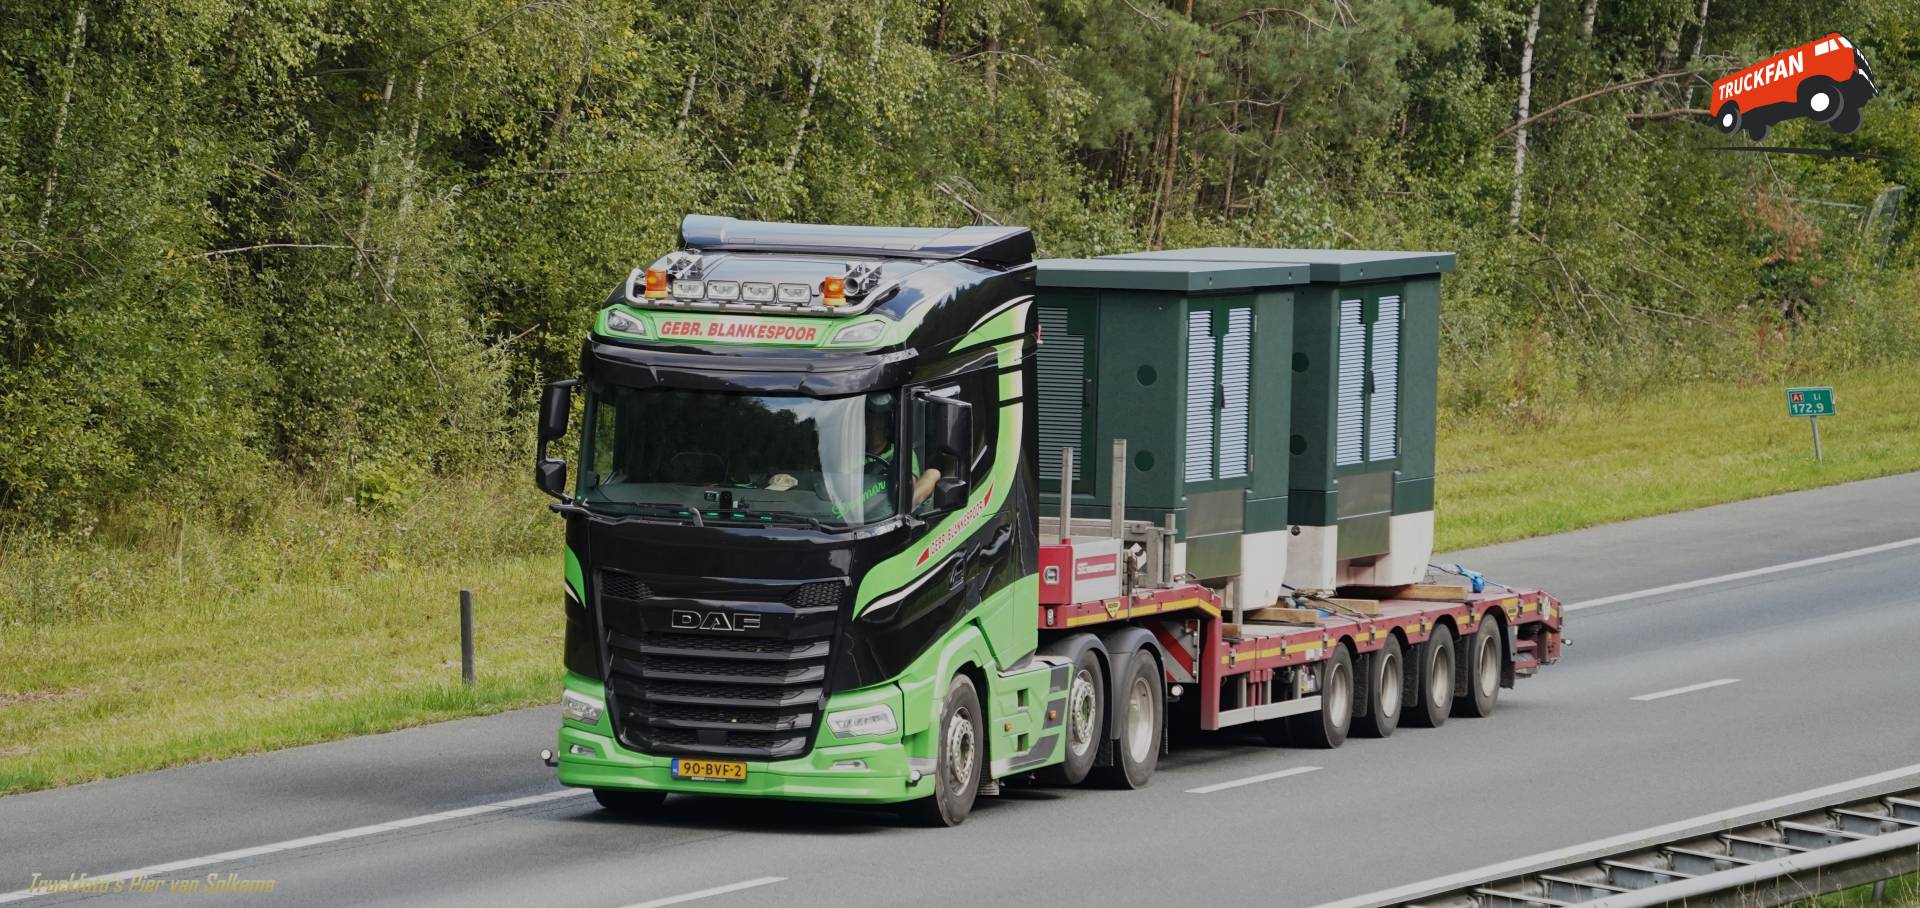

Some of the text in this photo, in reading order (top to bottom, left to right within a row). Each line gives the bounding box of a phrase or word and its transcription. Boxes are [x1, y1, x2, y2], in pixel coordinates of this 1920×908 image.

[661, 321, 817, 341] GEBR. BLANKESPOOR
[1793, 393, 1803, 401] A1
[947, 500, 984, 542] BLANKESPOOR
[671, 609, 761, 631] DAF
[684, 762, 742, 777] 90-BVF-2
